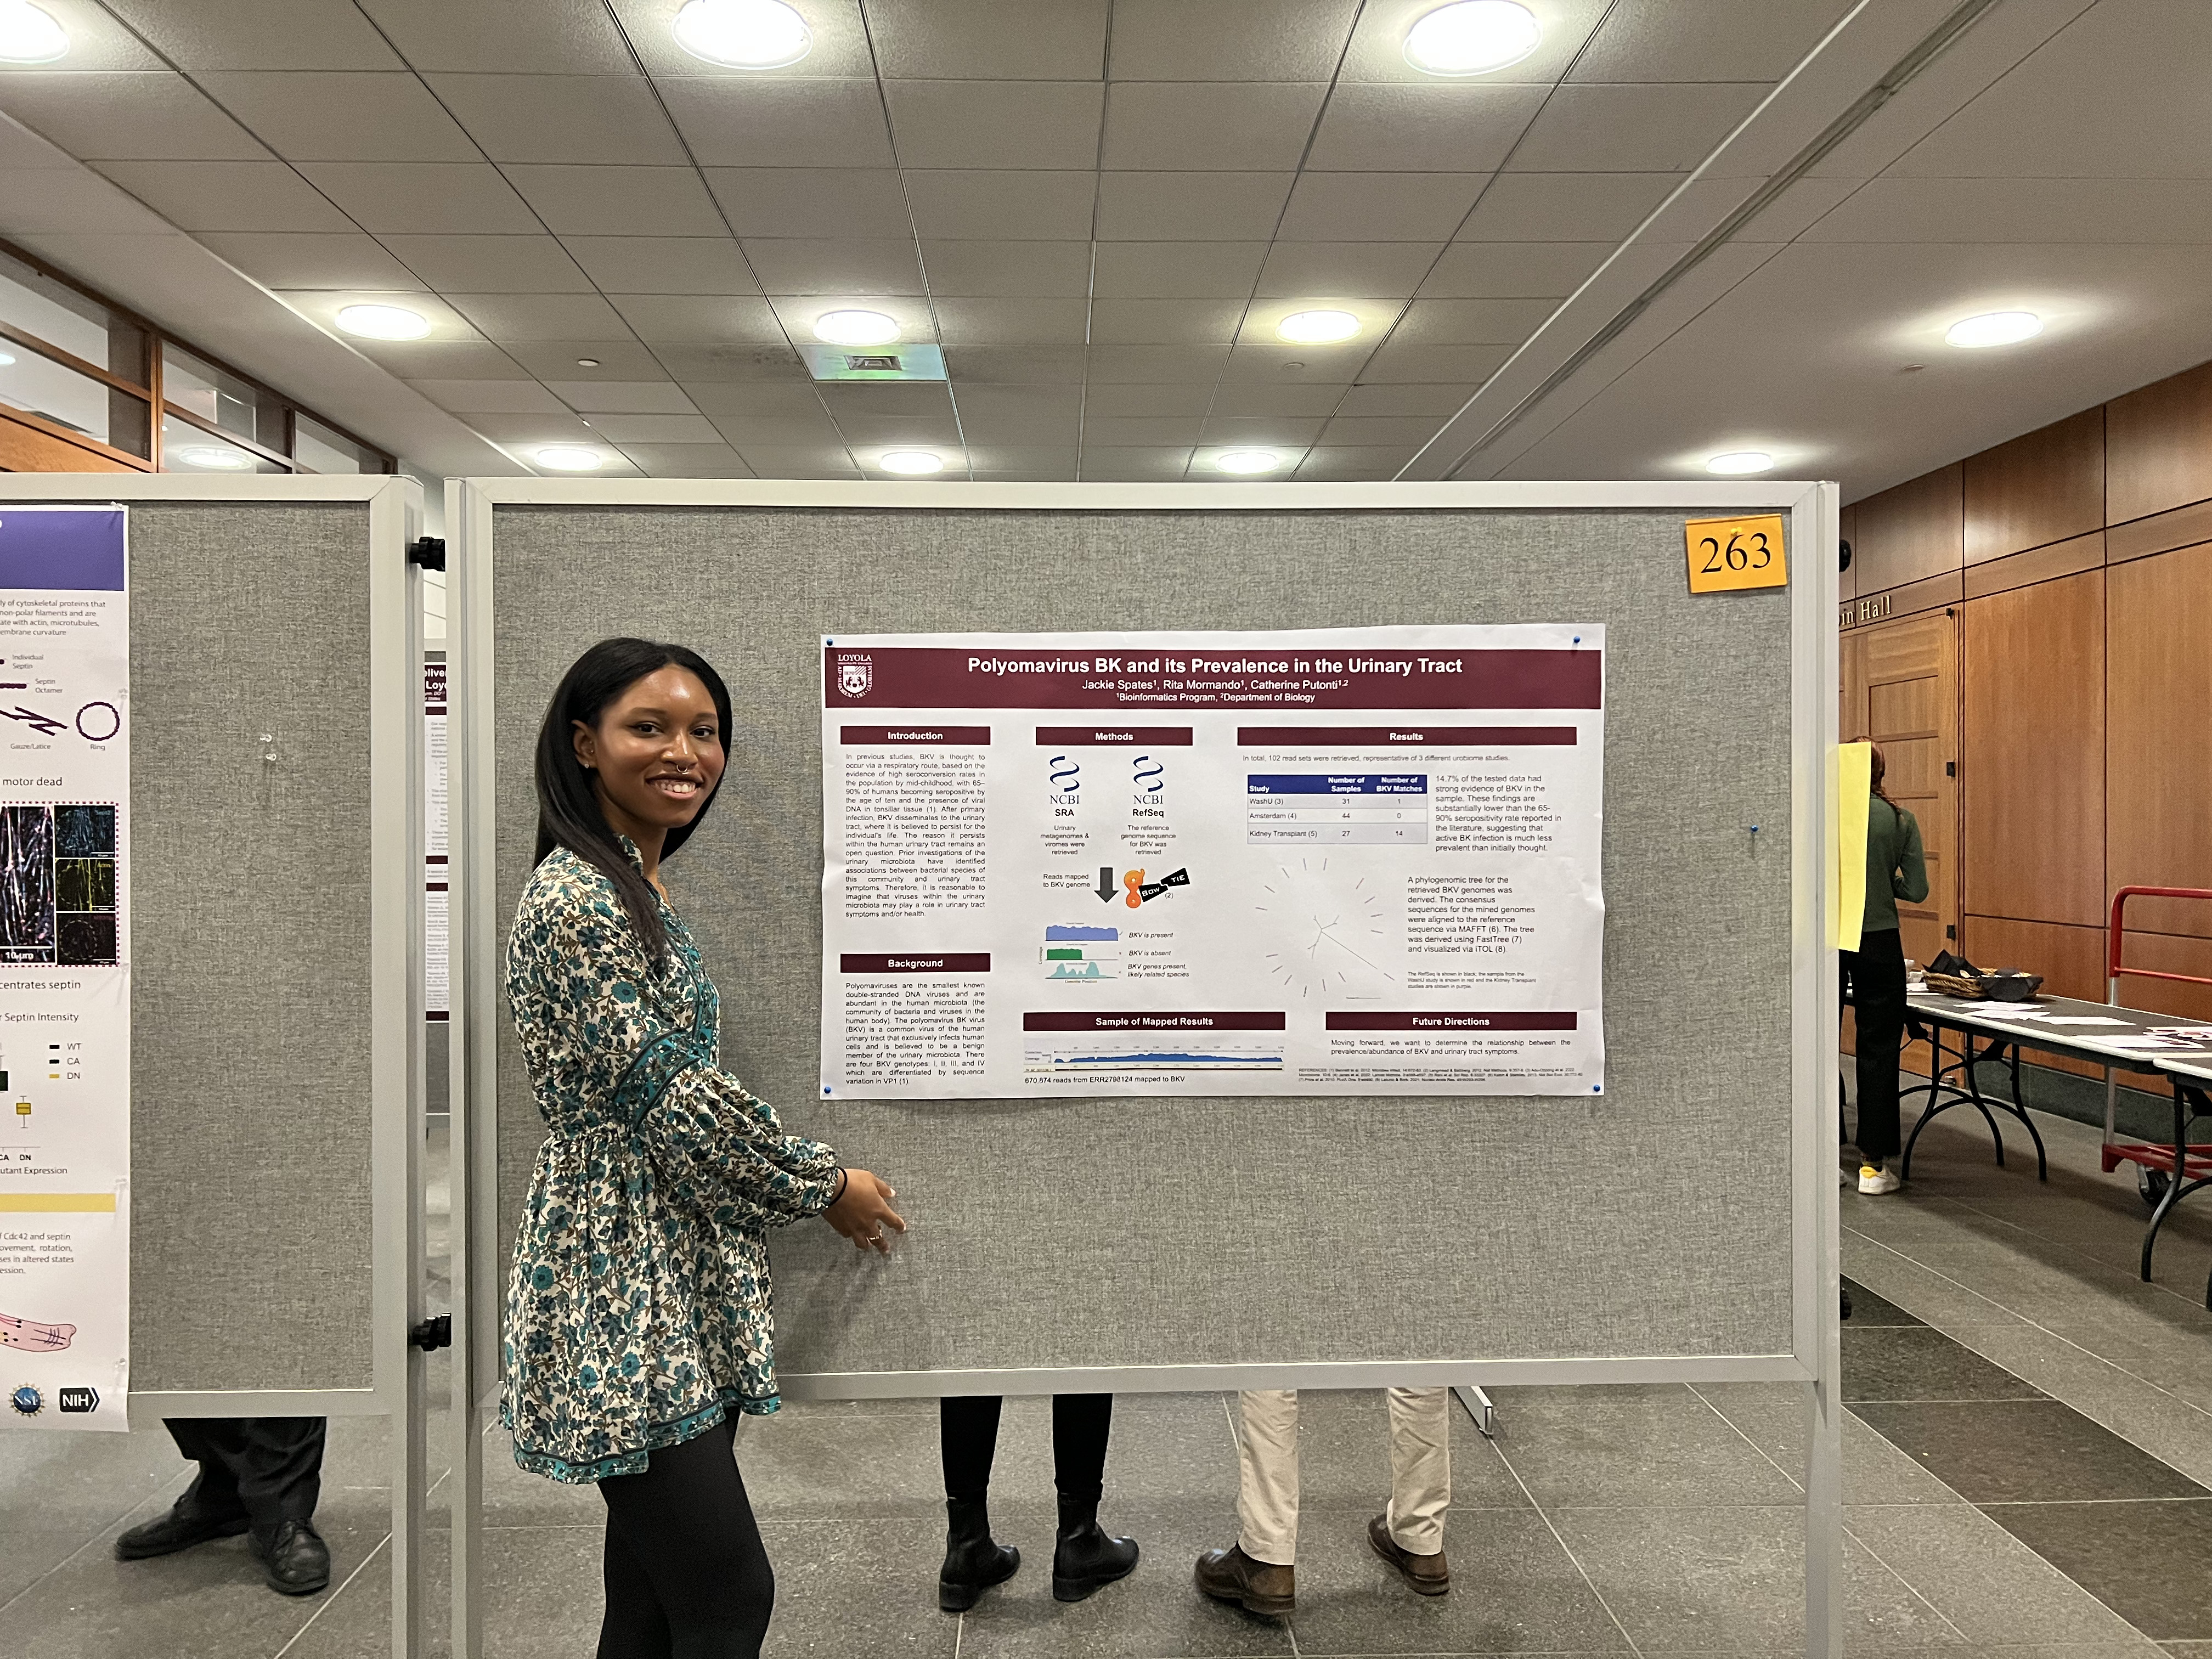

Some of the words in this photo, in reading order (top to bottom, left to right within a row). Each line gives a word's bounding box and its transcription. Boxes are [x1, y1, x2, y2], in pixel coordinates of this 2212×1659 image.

[1700, 533, 1771, 573] 263
[16, 600, 58, 608] cytoskeletal
[1860, 595, 1891, 620] Hall
[969, 658, 1089, 676] Polyomavirus
[1096, 658, 1121, 672] BK
[1127, 658, 1159, 673] and
[1166, 658, 1186, 673] its
[1192, 658, 1288, 673] Prevalence
[1295, 658, 1310, 673] in
[1315, 658, 1342, 673] the
[1349, 658, 1412, 676] Urinary
[1418, 658, 1462, 672] Tract
[1082, 680, 1114, 689] Jackie
[1164, 680, 1183, 689] Rita
[1251, 680, 1300, 689] Catherine
[1180, 693, 1217, 703] Program,
[1274, 692, 1283, 701] of
[1285, 693, 1315, 703] Biology
[888, 731, 943, 740] Introduction
[1095, 732, 1133, 741] Methods
[1390, 732, 1424, 741] Results
[90, 743, 106, 752] Ring
[2, 778, 34, 786] motor
[37, 777, 62, 786] dead
[1435, 775, 1460, 783] 14.7%
[1460, 775, 1470, 783] of
[1470, 775, 1483, 783] the
[1249, 785, 1270, 793] Study
[1331, 785, 1362, 793] Samples
[1050, 795, 1079, 804] NCBI
[1134, 795, 1163, 804] NCBI
[1133, 809, 1164, 818] RefSeq
[1249, 830, 1272, 838] Kidney
[1308, 830, 1318, 838] (5)
[1170, 874, 1186, 883] TIE
[1415, 876, 1467, 885] phylogenomic
[888, 960, 943, 969] Background
[0, 981, 46, 990] centrates
[49, 981, 81, 990] septin
[5, 1013, 35, 1023] Septin
[38, 1013, 78, 1023] Intensity
[1096, 1018, 1128, 1027] Sample
[1131, 1017, 1141, 1025] of
[1143, 1018, 1177, 1026] Mapped
[1180, 1017, 1214, 1025] Results
[1413, 1017, 1442, 1025] Future
[1444, 1017, 1490, 1026] Directions
[24, 1166, 67, 1175] Expression
[3, 1232, 28, 1240] Cdc42
[47, 1234, 71, 1242] septin
[63, 1394, 89, 1407] NIH
